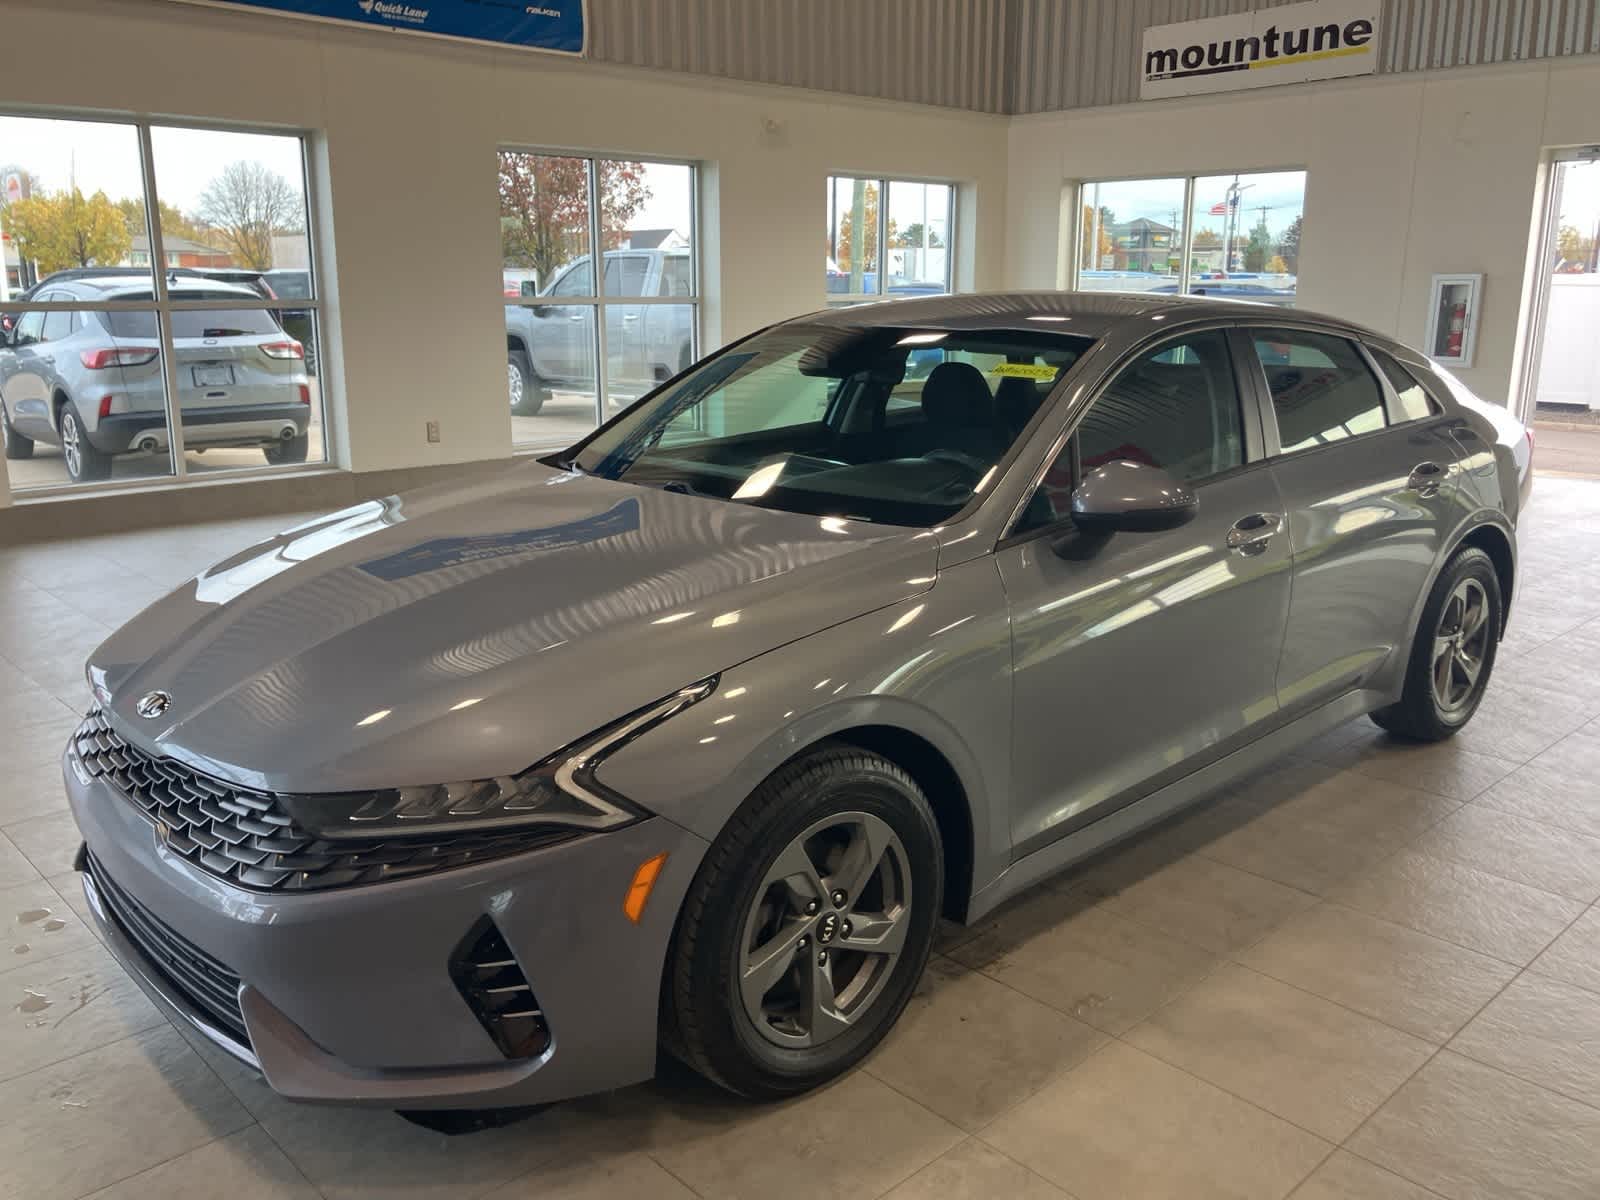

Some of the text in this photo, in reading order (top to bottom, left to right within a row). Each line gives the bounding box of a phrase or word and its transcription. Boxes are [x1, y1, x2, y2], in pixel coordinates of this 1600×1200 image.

[374, 1, 429, 18] Quick Lane
[1145, 19, 1373, 74] mountune
[822, 916, 835, 941] KIA
